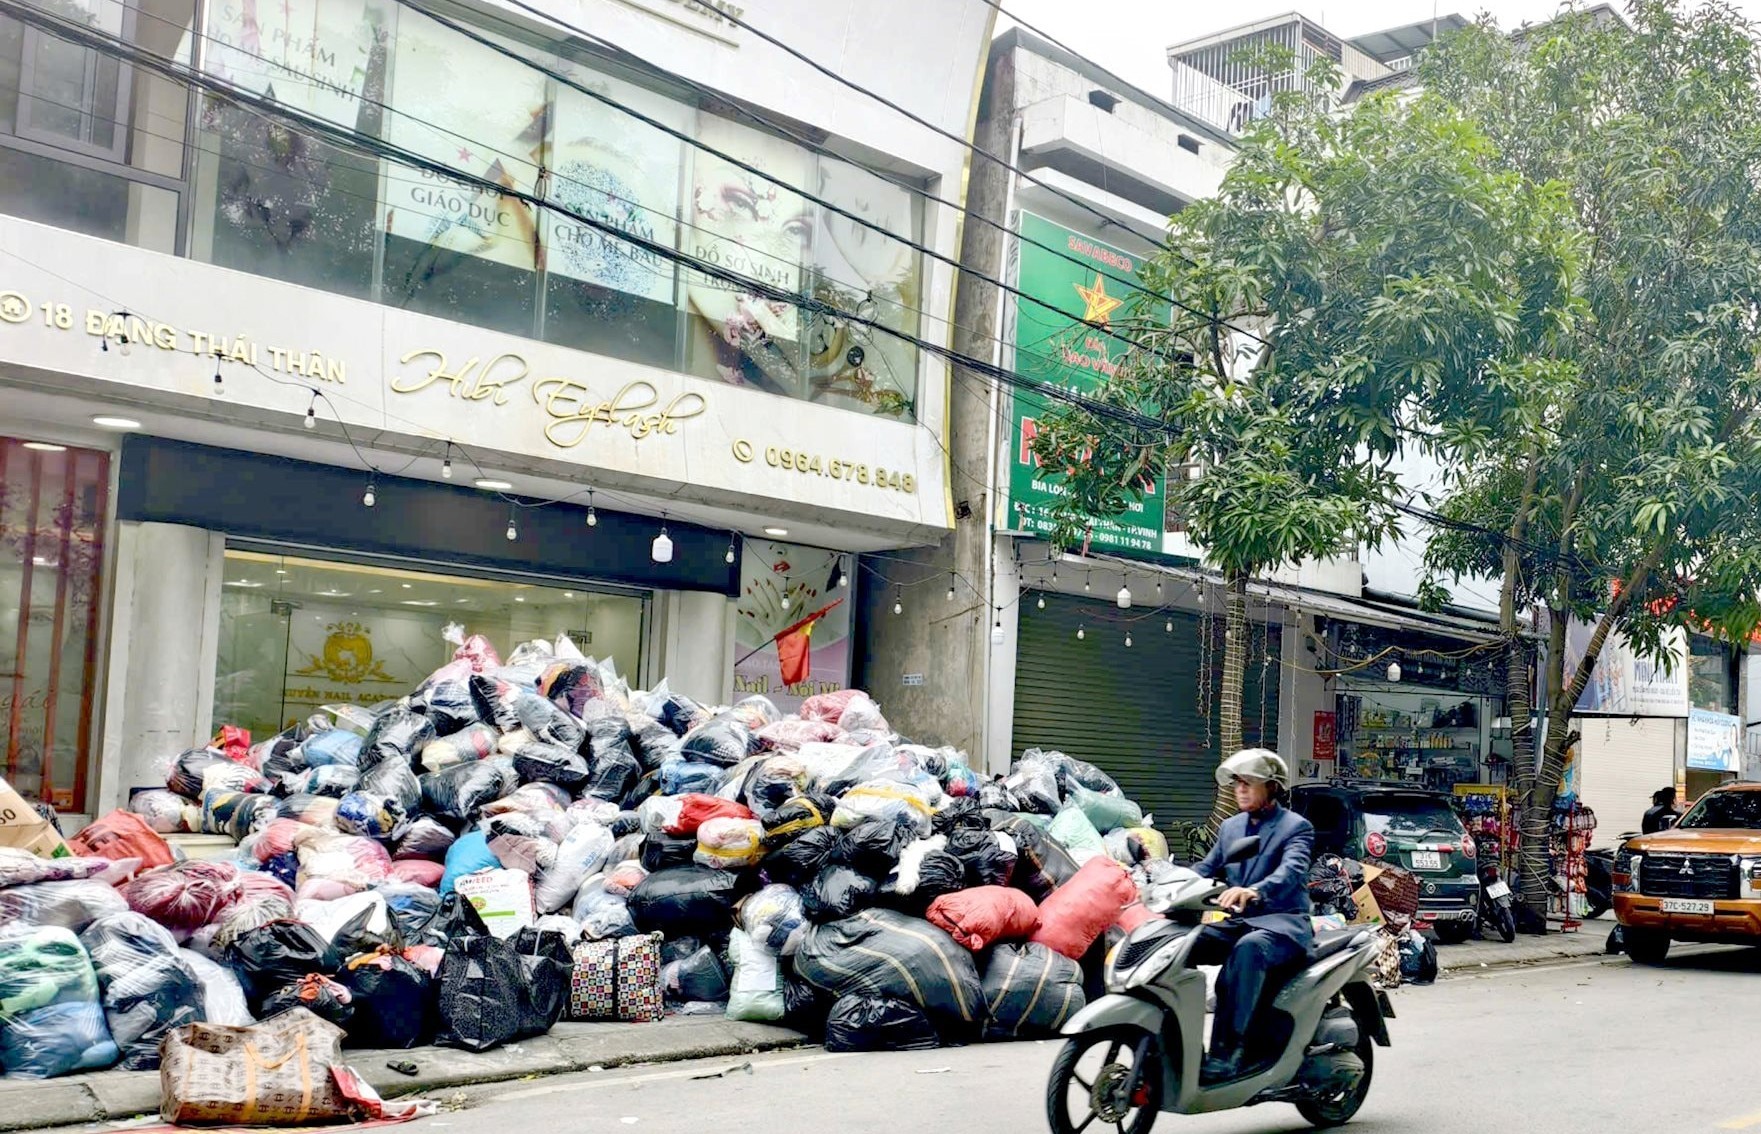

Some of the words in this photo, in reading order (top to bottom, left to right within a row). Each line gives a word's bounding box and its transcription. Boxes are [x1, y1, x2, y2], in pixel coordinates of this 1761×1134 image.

[410, 186, 462, 213] GIÁO
[468, 202, 511, 227] DỤC
[695, 244, 720, 264] ĐỒ
[725, 253, 747, 271] SƠ
[750, 263, 790, 285] SINH
[1067, 235, 1133, 273] SAVABECO
[40, 301, 74, 330] 18
[187, 329, 258, 367] THÁI
[267, 344, 347, 384] THÂN
[764, 445, 916, 494] 0964.678.848
[1031, 479, 1047, 493] BIA
[1663, 901, 1710, 912] 37C-527.29
